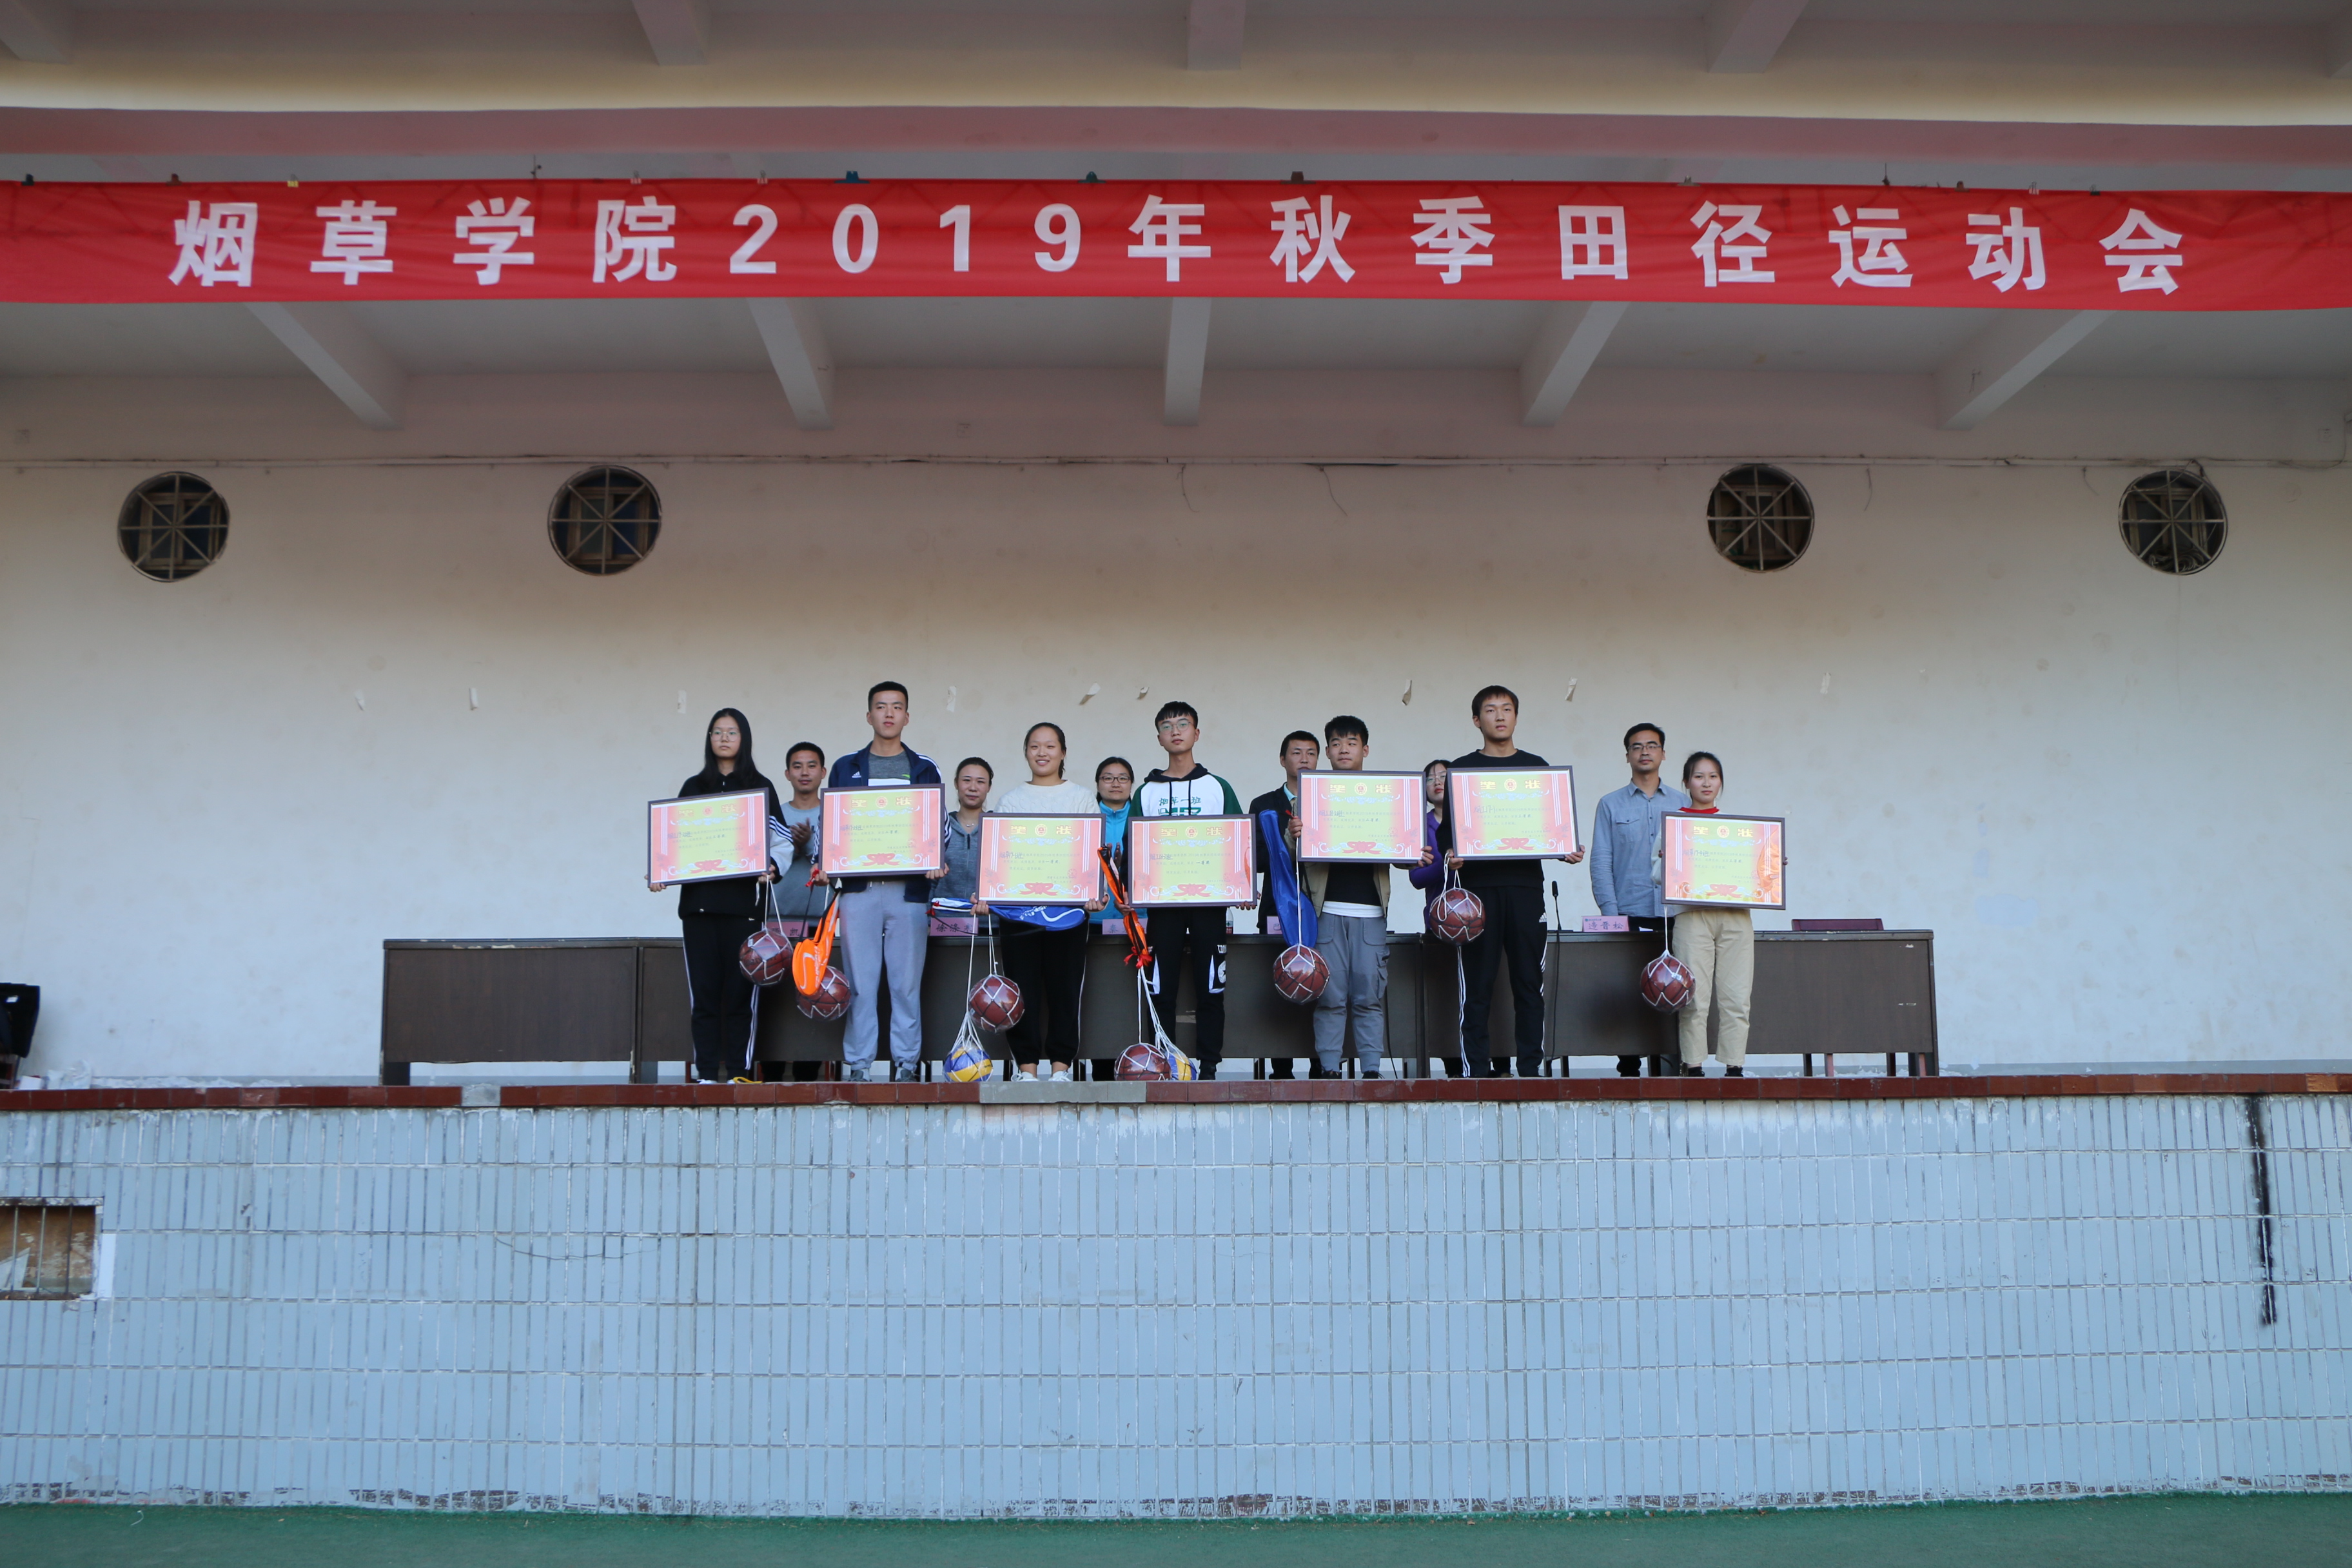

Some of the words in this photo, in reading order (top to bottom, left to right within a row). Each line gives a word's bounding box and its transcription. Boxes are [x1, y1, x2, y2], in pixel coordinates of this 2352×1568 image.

[169, 195, 2182, 295] 烟草学院2019年秋季田径运动会
